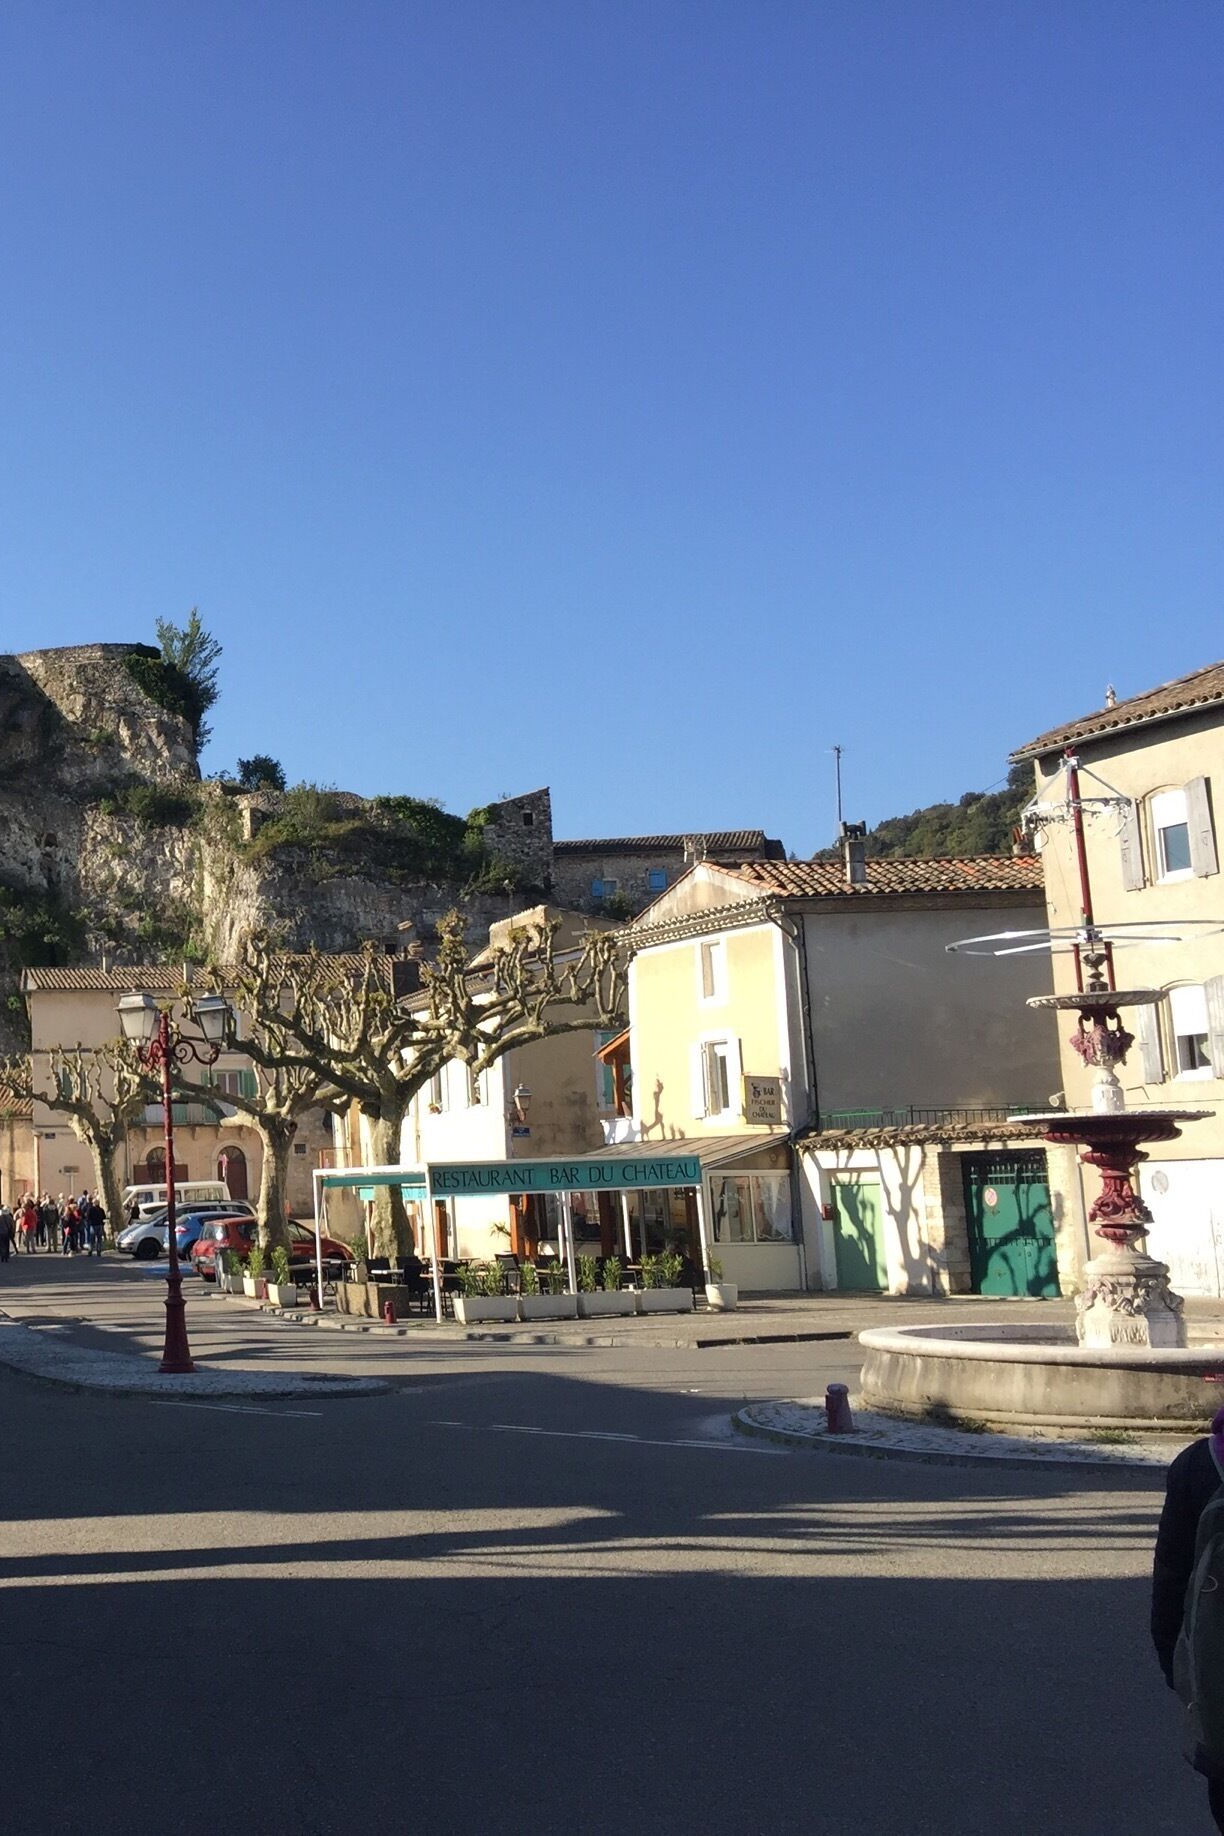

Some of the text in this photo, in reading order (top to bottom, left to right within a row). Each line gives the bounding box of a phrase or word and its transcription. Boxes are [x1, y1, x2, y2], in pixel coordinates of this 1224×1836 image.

[432, 1162, 696, 1188] RESTAURANT BAR DU CHATEAU
